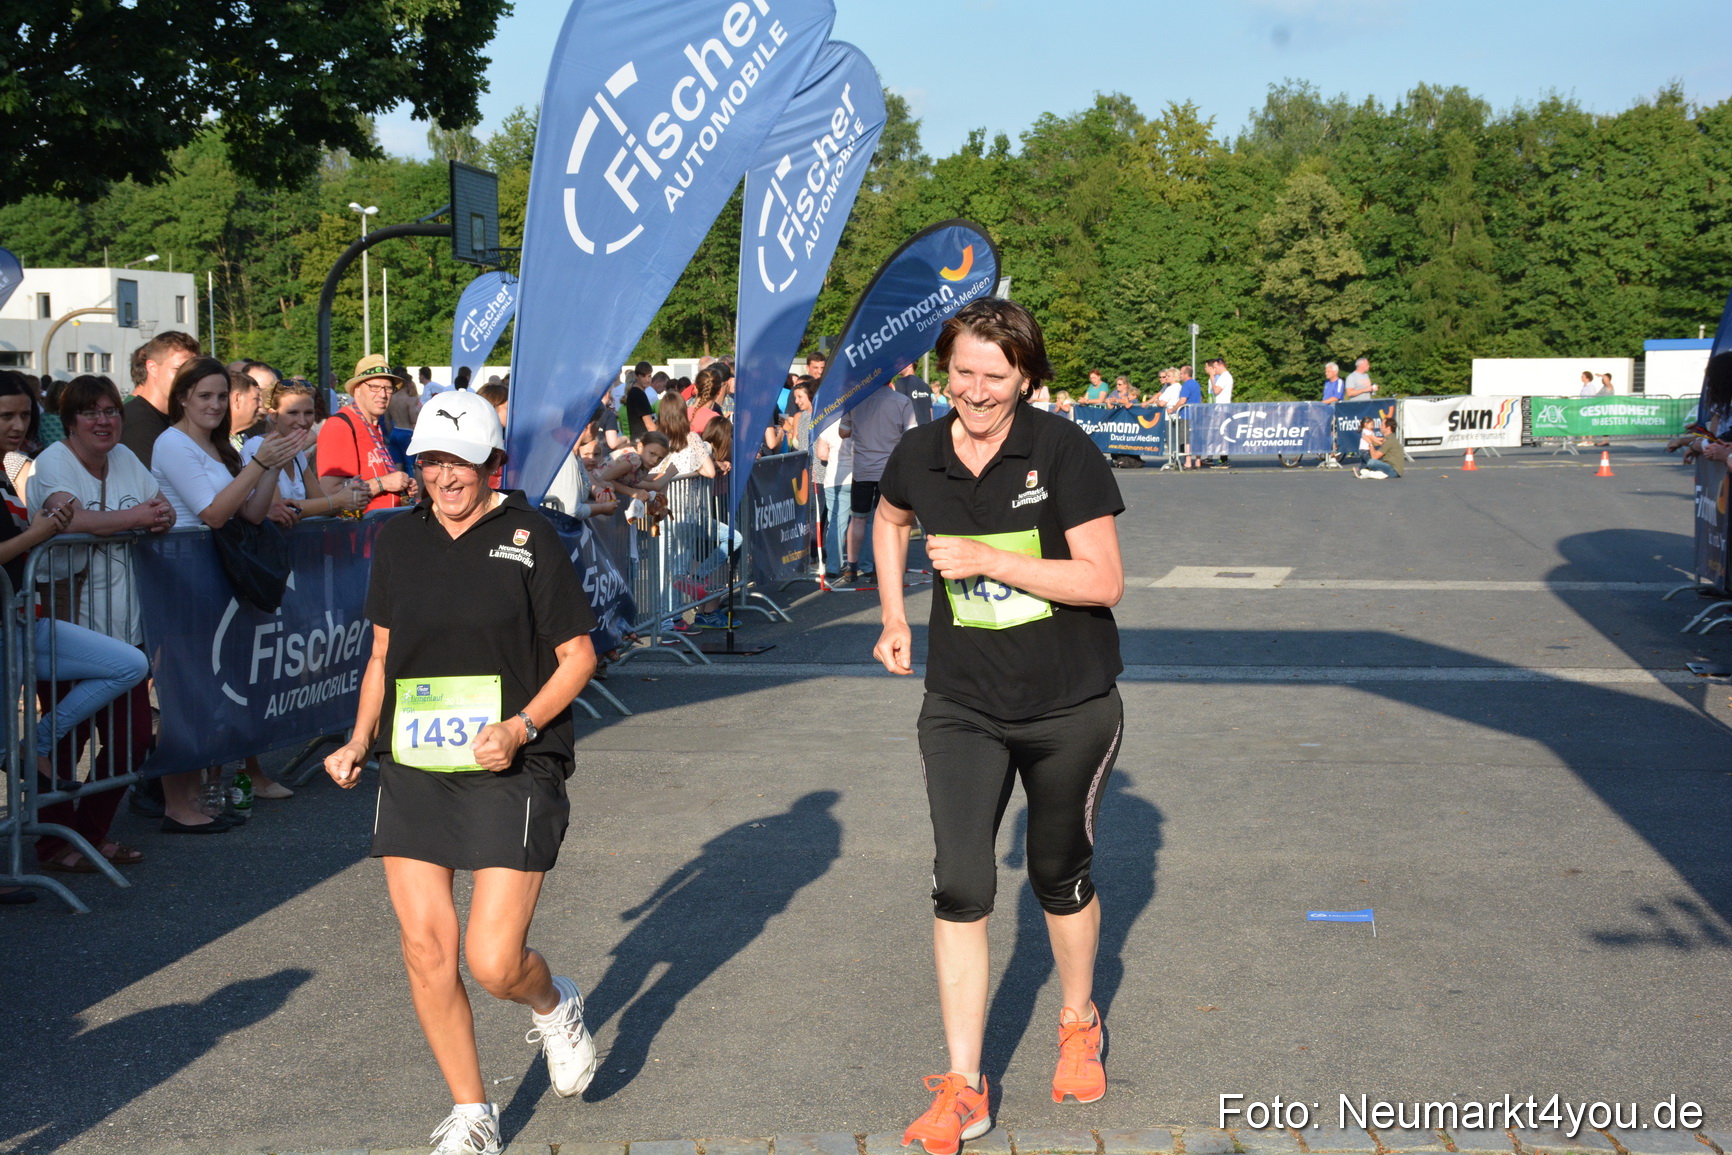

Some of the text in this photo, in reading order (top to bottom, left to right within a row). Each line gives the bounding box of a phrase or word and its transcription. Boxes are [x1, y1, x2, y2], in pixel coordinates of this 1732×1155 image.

[663, 19, 788, 214] AUTOMOBILE
[777, 82, 855, 262] Fischer
[470, 285, 509, 342] Fischer
[916, 310, 943, 333] Druck
[959, 277, 990, 304] Medien
[844, 285, 954, 368] Frischmann
[1236, 423, 1309, 438] Fischer
[1536, 404, 1568, 423] AOK
[1579, 404, 1661, 418] GESUNDHEIT
[1243, 439, 1303, 447] AUTOMOBILE
[489, 549, 535, 568] Lammsbräu
[954, 575, 1029, 602] 143
[249, 610, 371, 685] Fischer
[264, 668, 359, 720] AUTOMOBILE
[405, 716, 489, 749] 1437
